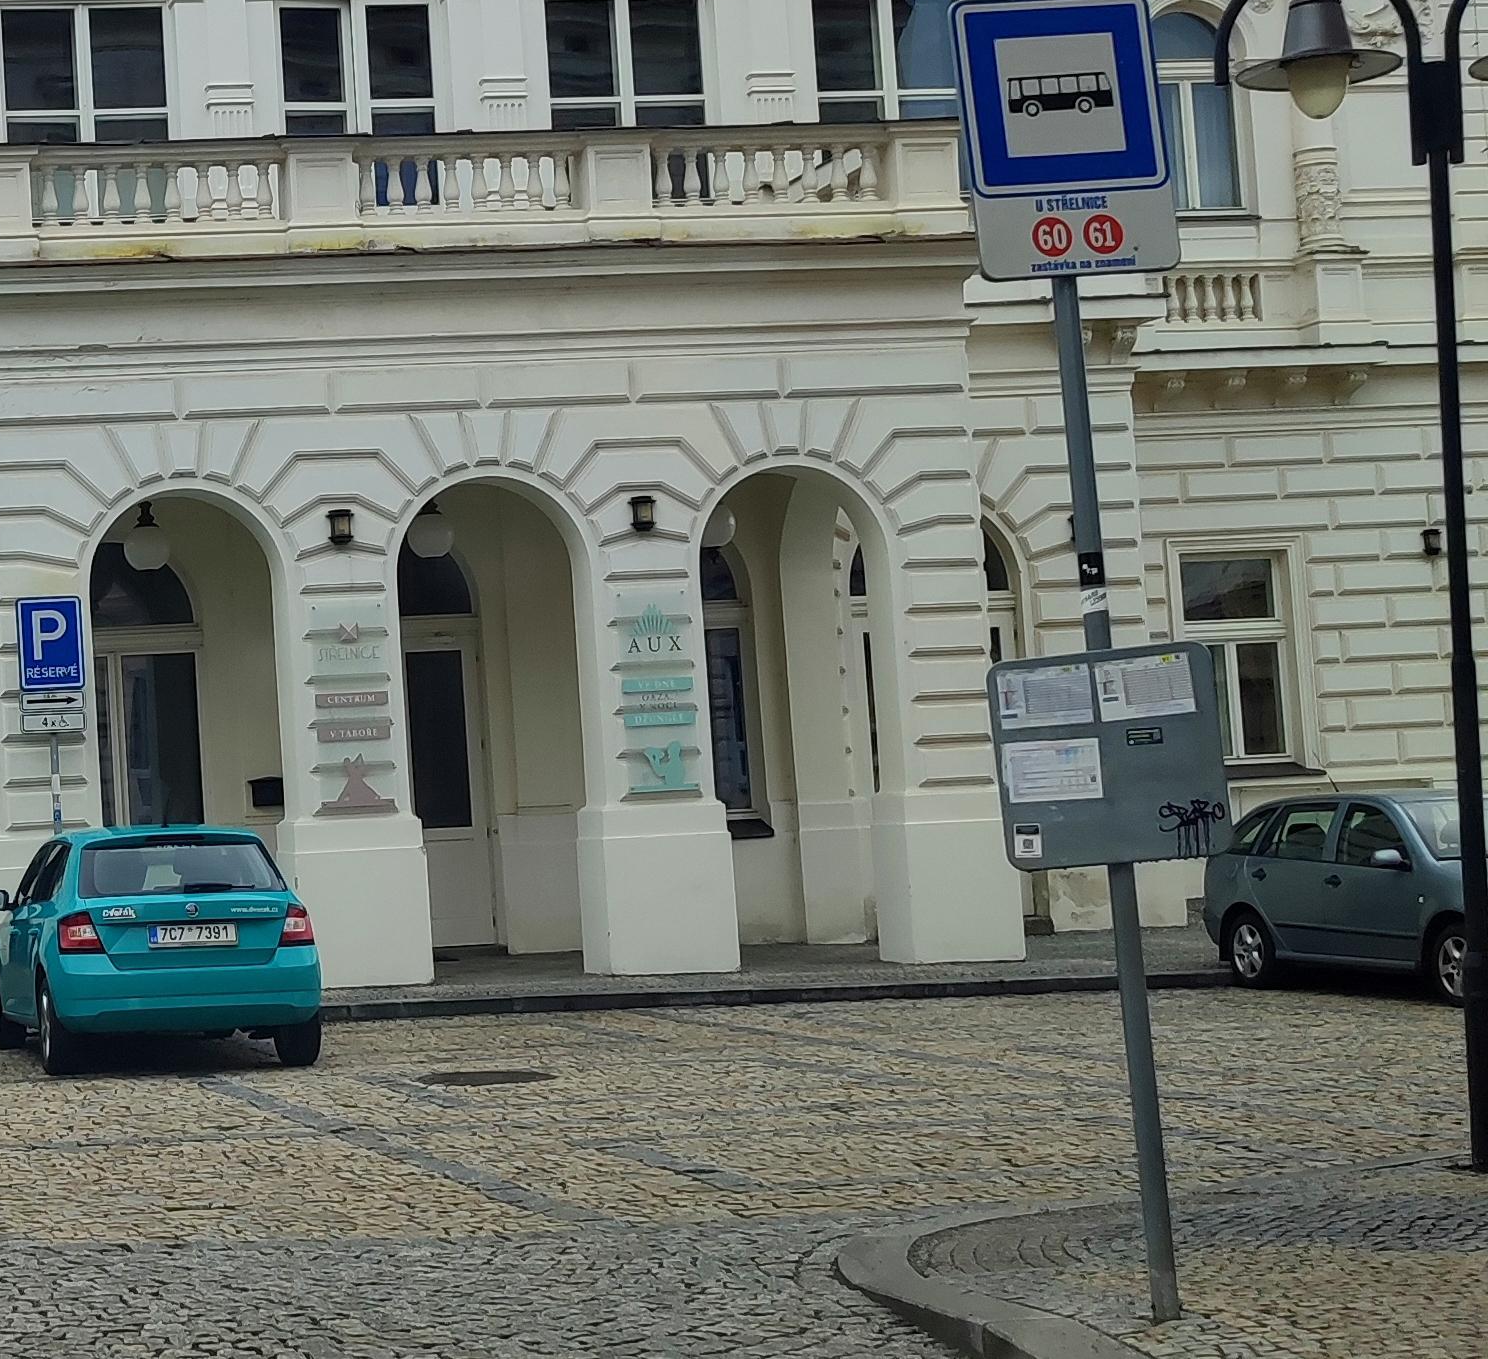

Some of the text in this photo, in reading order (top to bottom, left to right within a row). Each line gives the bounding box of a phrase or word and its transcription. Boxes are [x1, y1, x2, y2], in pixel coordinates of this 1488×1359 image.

[1036, 195, 1108, 212] U STŘELNICE
[1038, 221, 1115, 250] 60 61
[1031, 259, 1077, 272] zastávka
[1080, 261, 1093, 269] na
[31, 609, 67, 661] P
[628, 636, 682, 653] AUX
[26, 663, 79, 678] RÉSERVÉ
[327, 694, 376, 704] CENTRUM
[160, 925, 228, 941] 7C7 7391
